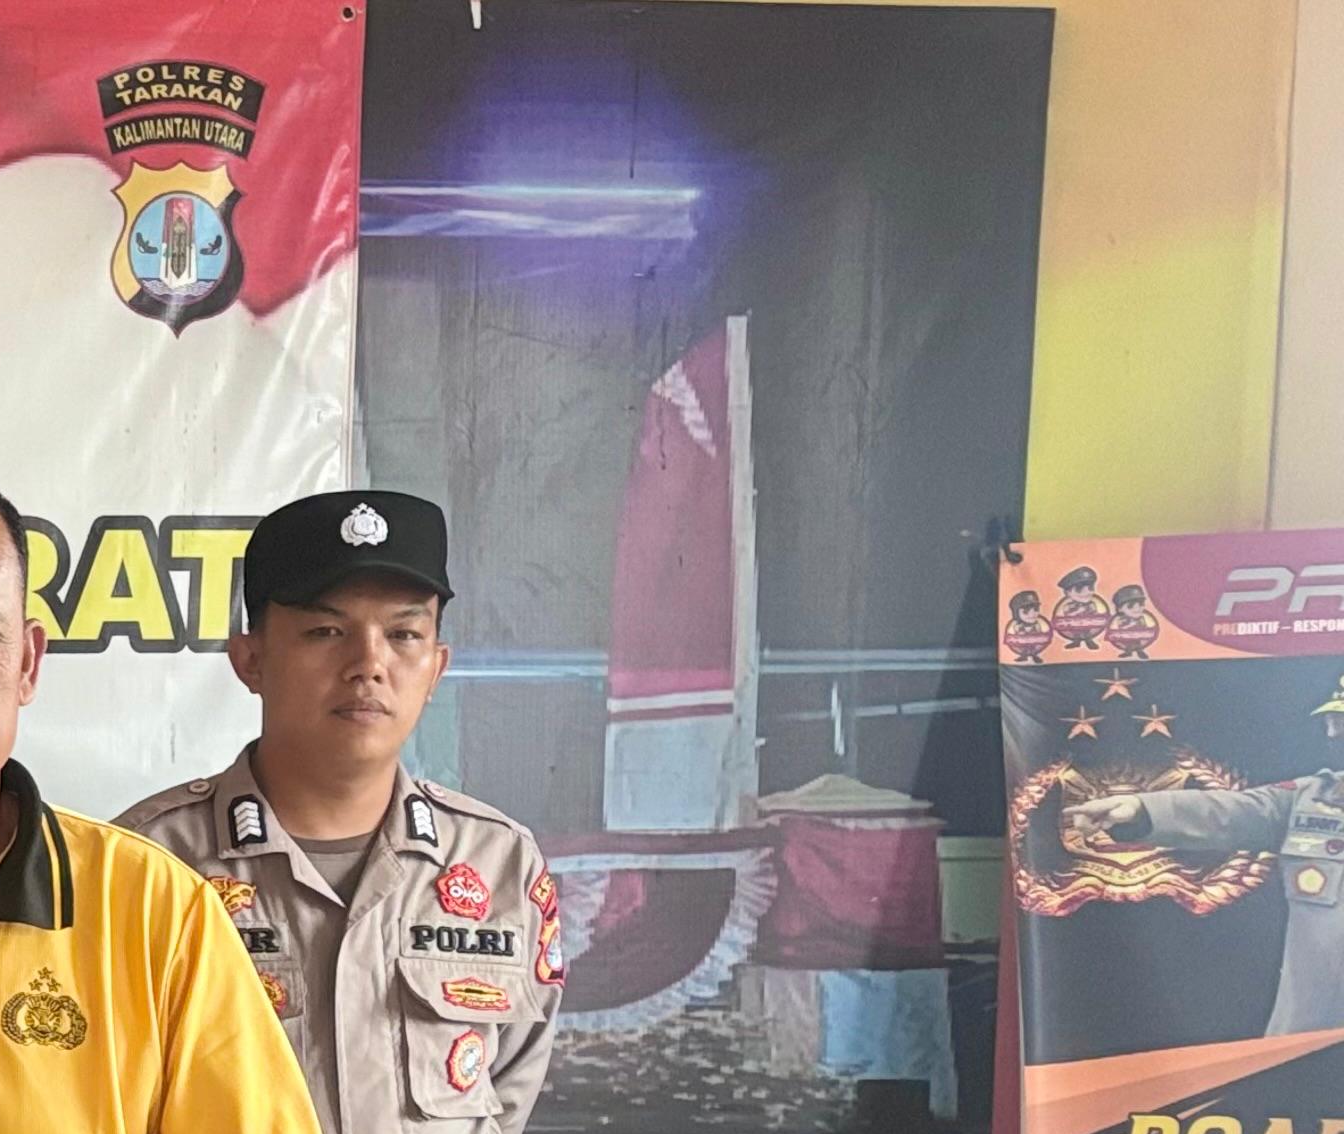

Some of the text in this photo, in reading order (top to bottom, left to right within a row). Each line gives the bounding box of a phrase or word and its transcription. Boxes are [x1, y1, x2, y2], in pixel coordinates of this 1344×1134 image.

[113, 64, 246, 91] POLRES
[115, 83, 243, 111] TARAKAN
[112, 116, 245, 151] KALIMANTAN UTARA
[410, 924, 515, 957] POLRI
